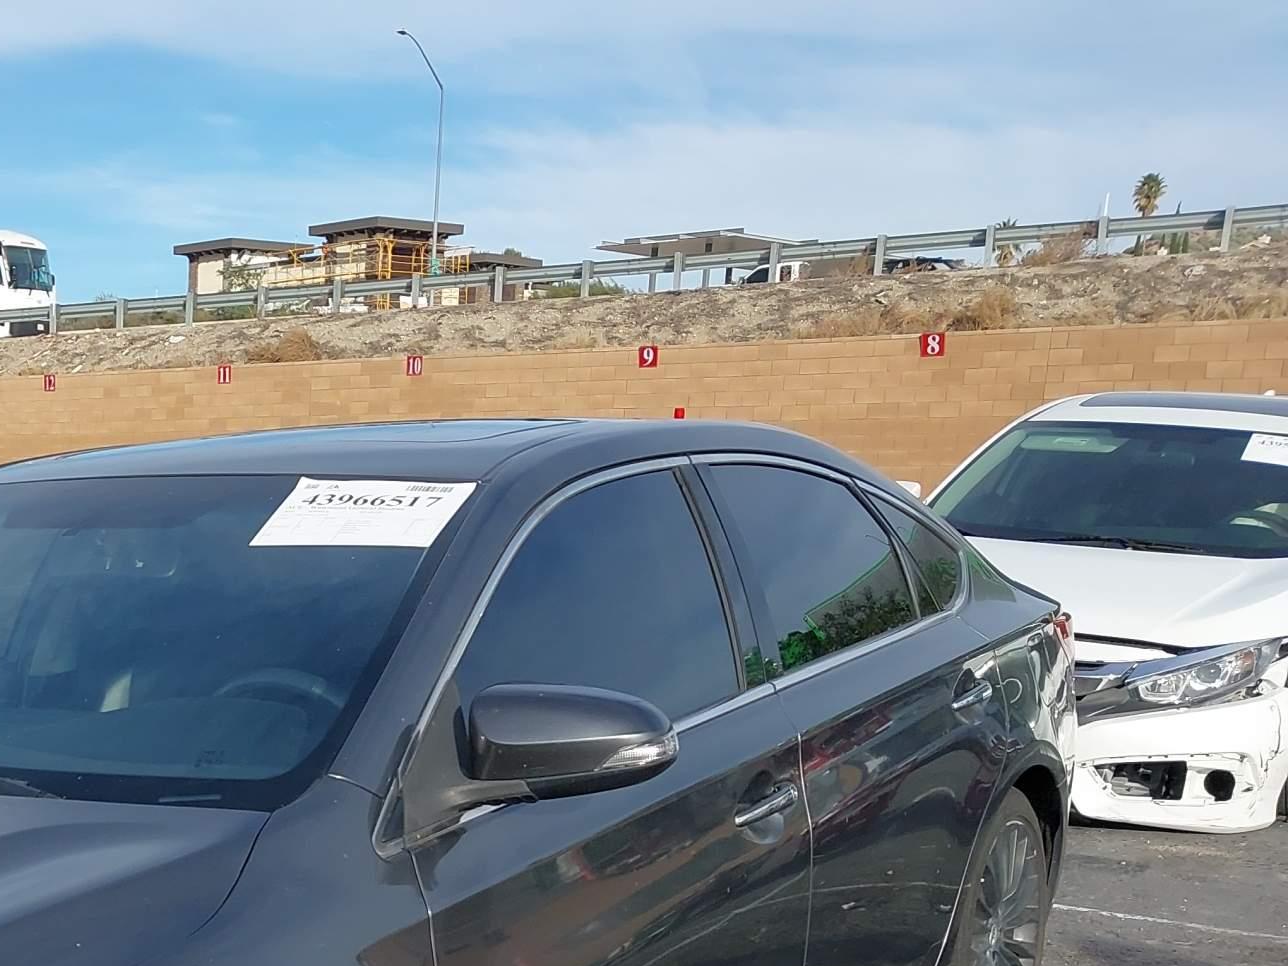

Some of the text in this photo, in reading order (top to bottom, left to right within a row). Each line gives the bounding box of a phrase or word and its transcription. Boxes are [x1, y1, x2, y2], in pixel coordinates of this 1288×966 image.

[927, 334, 940, 354] 8
[643, 347, 654, 366] 9
[408, 357, 421, 374] 10
[219, 367, 230, 383] 11
[45, 377, 55, 390] 12
[301, 493, 444, 508] 43966517
